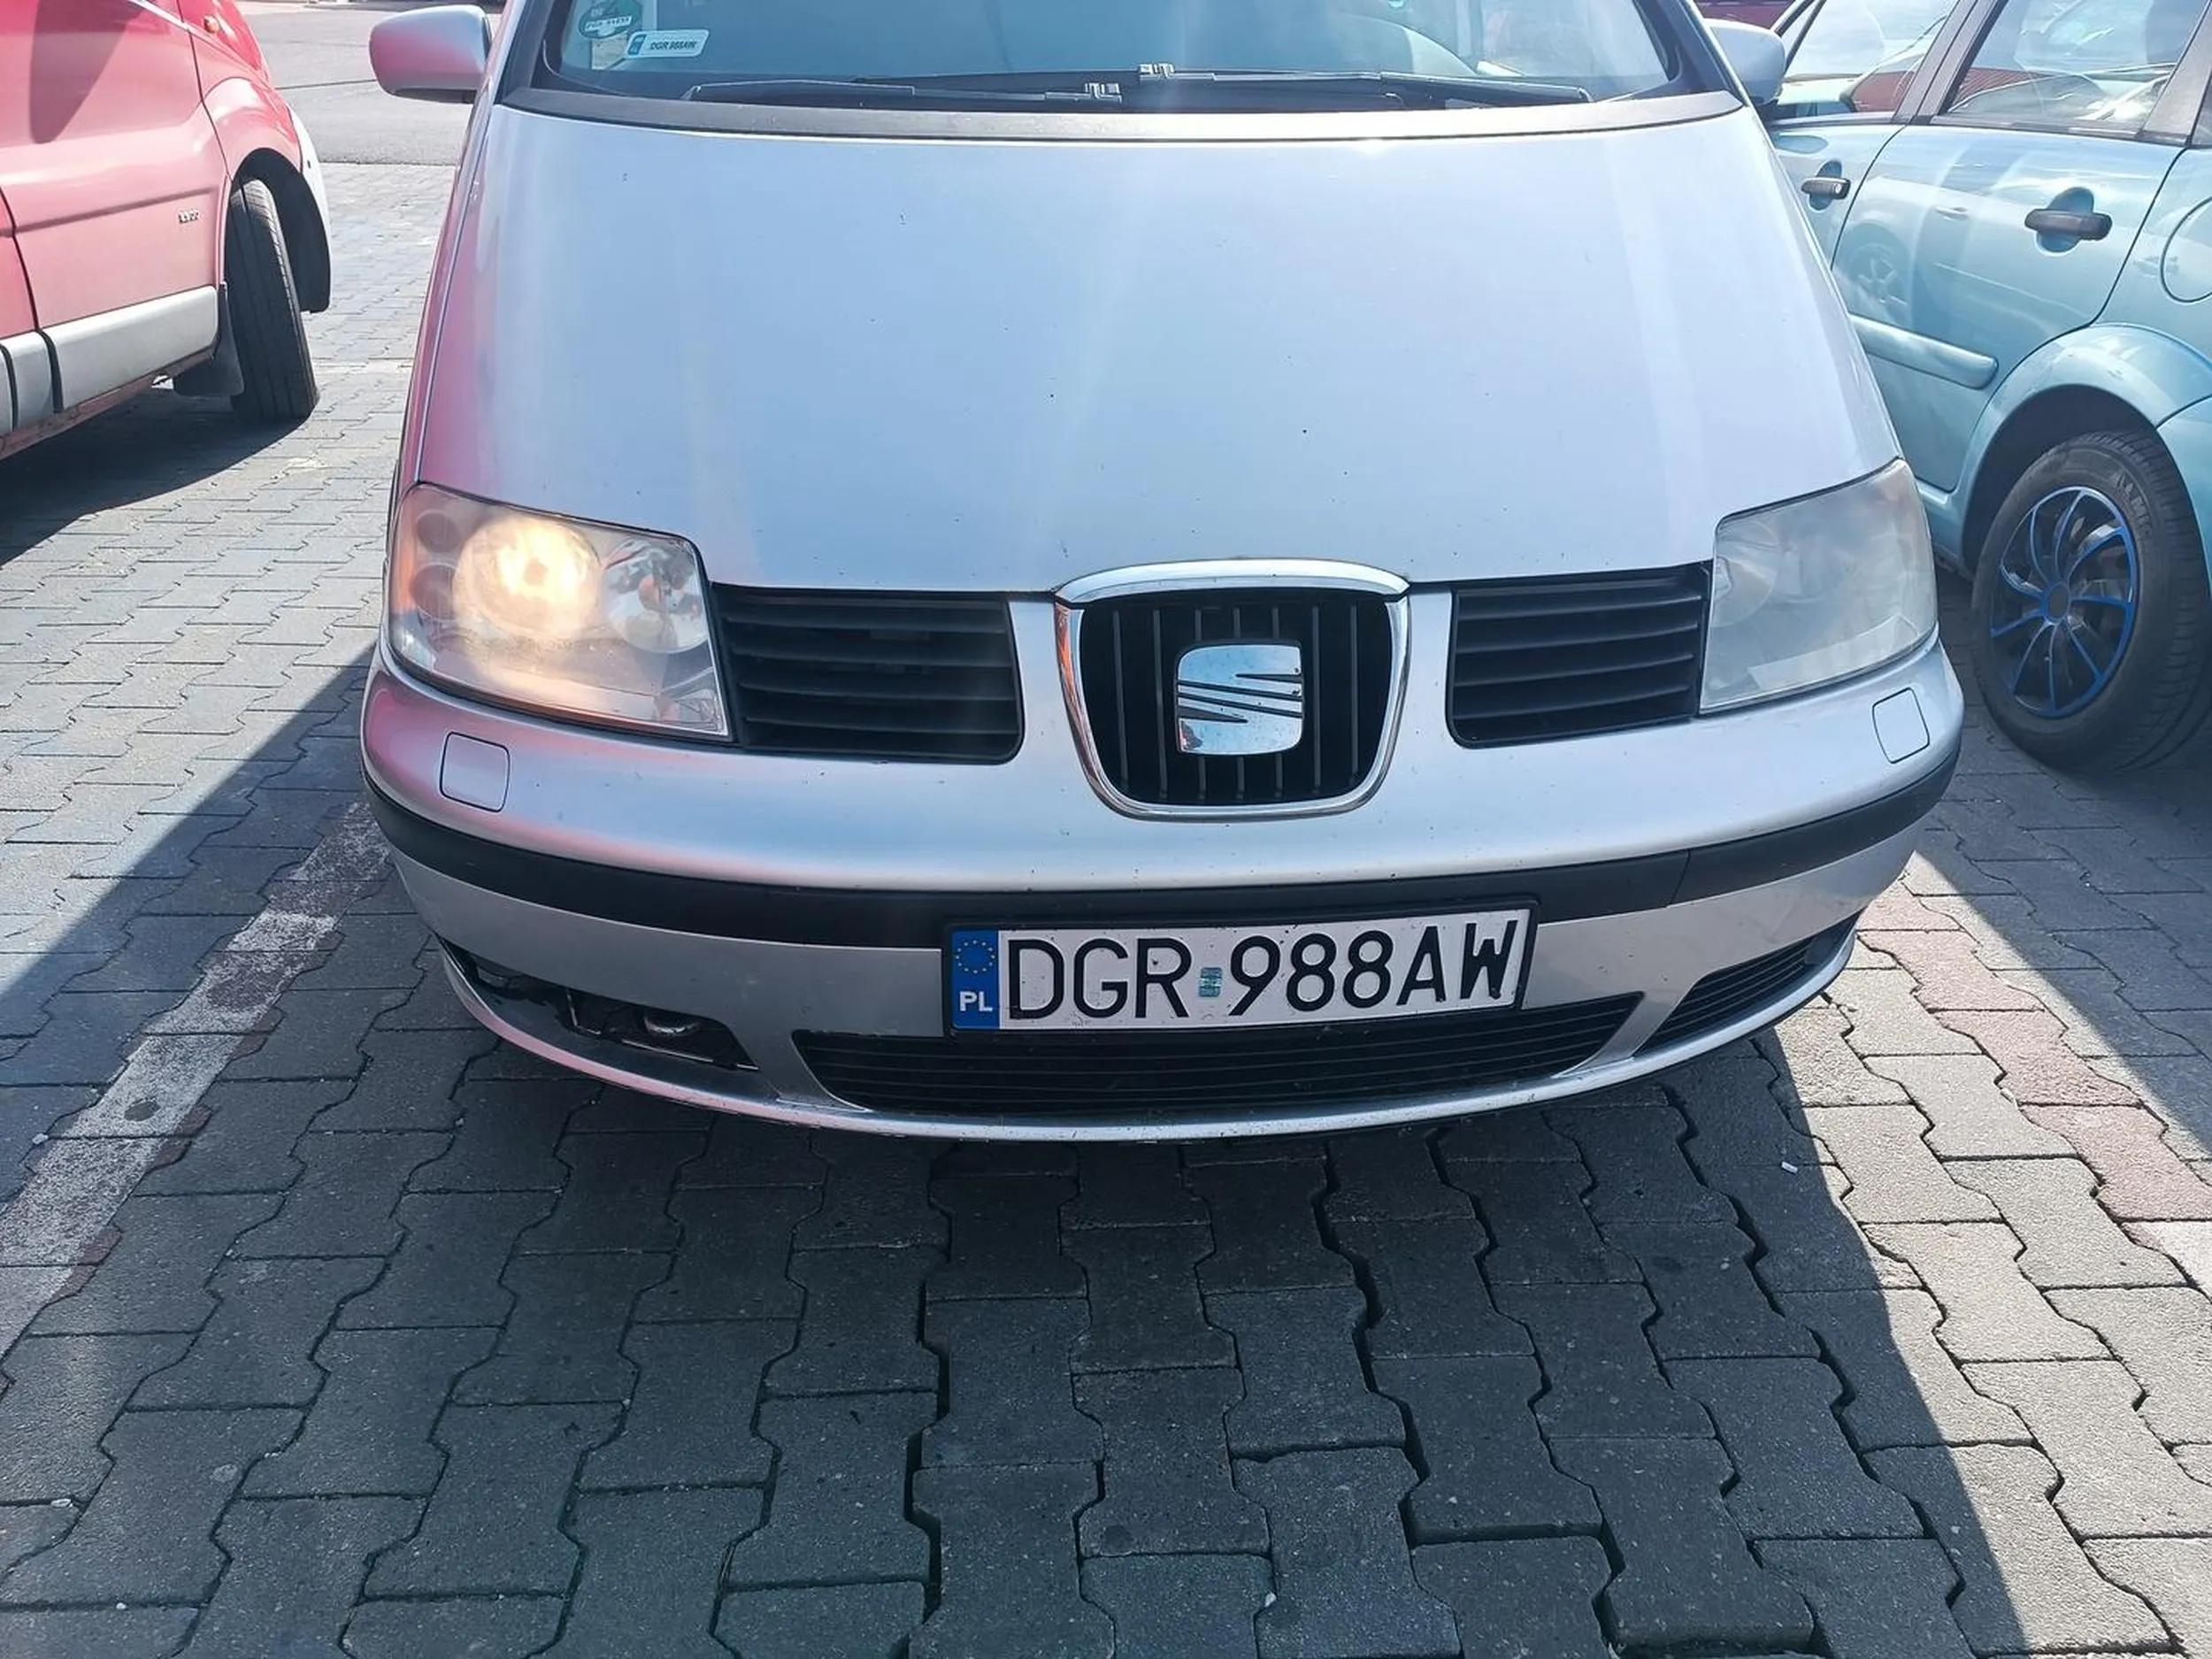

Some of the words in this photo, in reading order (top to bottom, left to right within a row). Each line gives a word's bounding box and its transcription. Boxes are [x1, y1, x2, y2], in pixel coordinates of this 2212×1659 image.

[1008, 937, 1193, 1019] DGR
[1228, 919, 1519, 1016] 988AW
[959, 990, 993, 1012] PL
